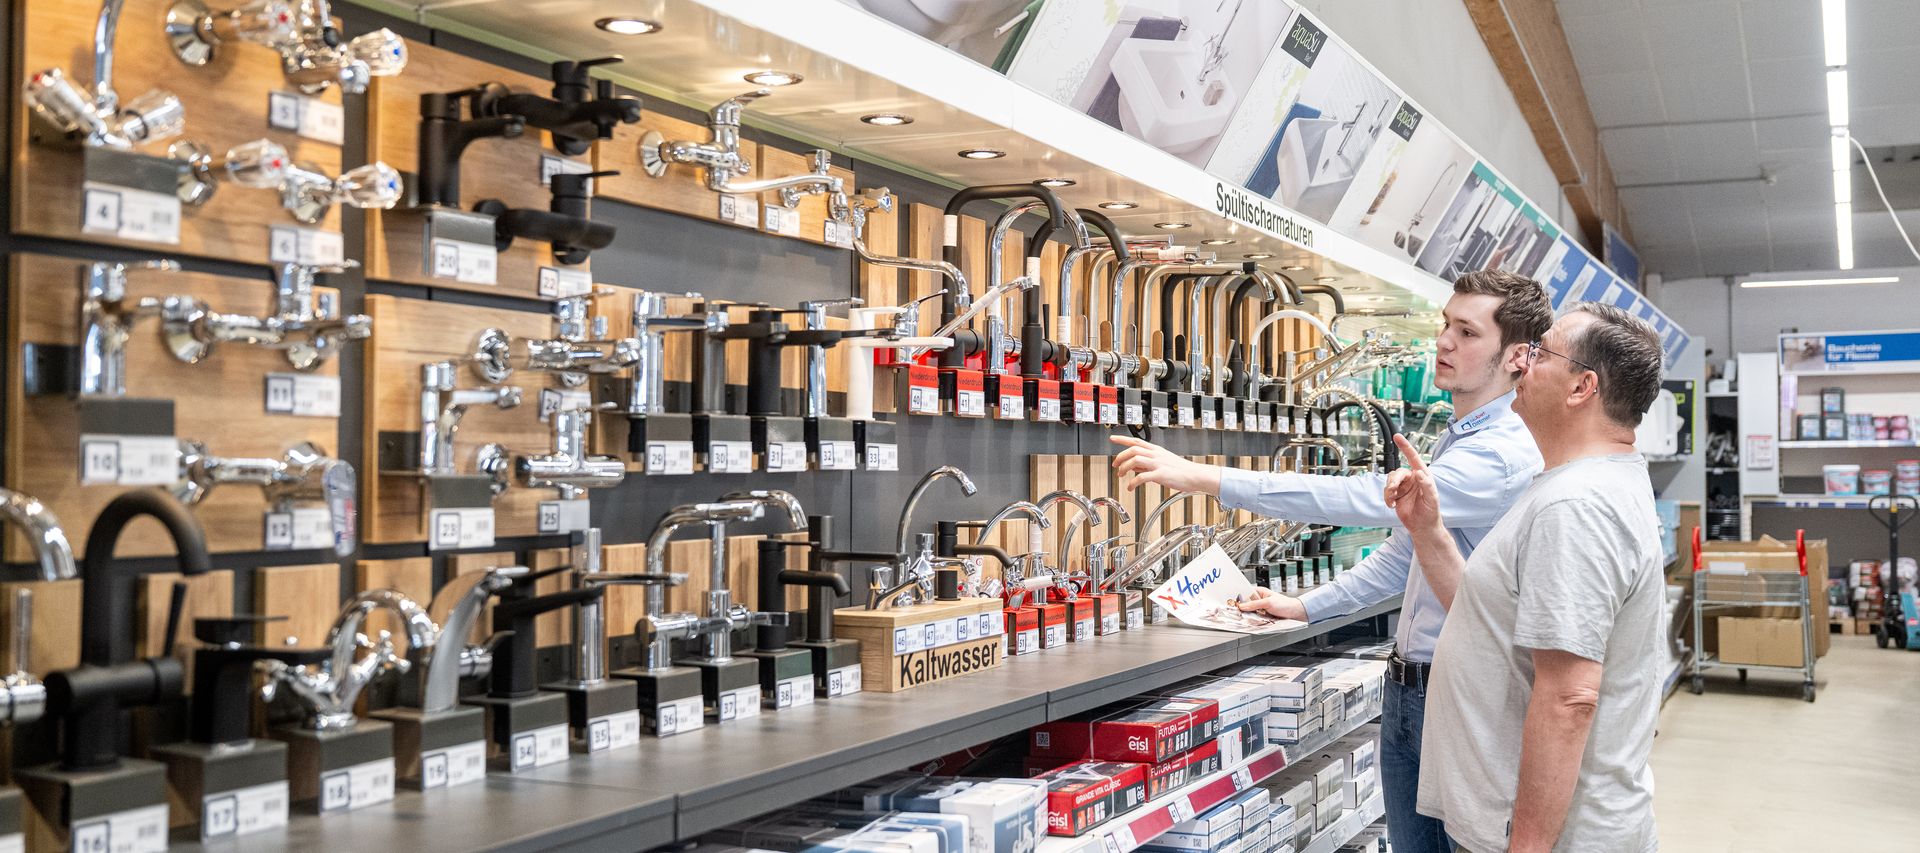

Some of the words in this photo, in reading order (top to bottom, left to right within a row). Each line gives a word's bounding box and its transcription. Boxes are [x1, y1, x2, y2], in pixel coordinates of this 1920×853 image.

[280, 106, 290, 120] 5
[98, 205, 109, 219] 4
[723, 202, 734, 214] 26
[1216, 182, 1313, 248] Spültischarmaturen
[440, 255, 456, 268] 20
[543, 277, 556, 289] 22
[272, 388, 288, 401] 11
[913, 395, 920, 405] 40
[1003, 403, 1009, 412] 42
[652, 453, 663, 465] 29
[715, 450, 725, 463] 30
[771, 450, 780, 462] 31
[824, 449, 832, 461] 32
[869, 452, 877, 463] 33
[91, 455, 112, 471] 10
[544, 513, 557, 526] 25
[271, 523, 288, 537] 12
[1176, 566, 1222, 598] Home
[959, 624, 966, 634] 48
[981, 620, 988, 630] 49
[927, 631, 934, 641] 47
[1019, 639, 1025, 648] 51
[900, 642, 998, 688] Kaltwasser
[831, 679, 840, 690] 39
[780, 690, 790, 702] 38
[723, 702, 734, 714] 37
[663, 714, 674, 726] 36
[595, 729, 608, 742] 35
[1158, 724, 1178, 738] FUTURA
[1128, 735, 1149, 751] eisl
[519, 746, 533, 759] 34
[428, 765, 444, 778] 19
[1151, 762, 1172, 778] FUTURA
[1075, 791, 1095, 804] GRANDE
[1095, 787, 1104, 797] VITA
[213, 808, 232, 825] 17
[1048, 811, 1068, 827] eisl
